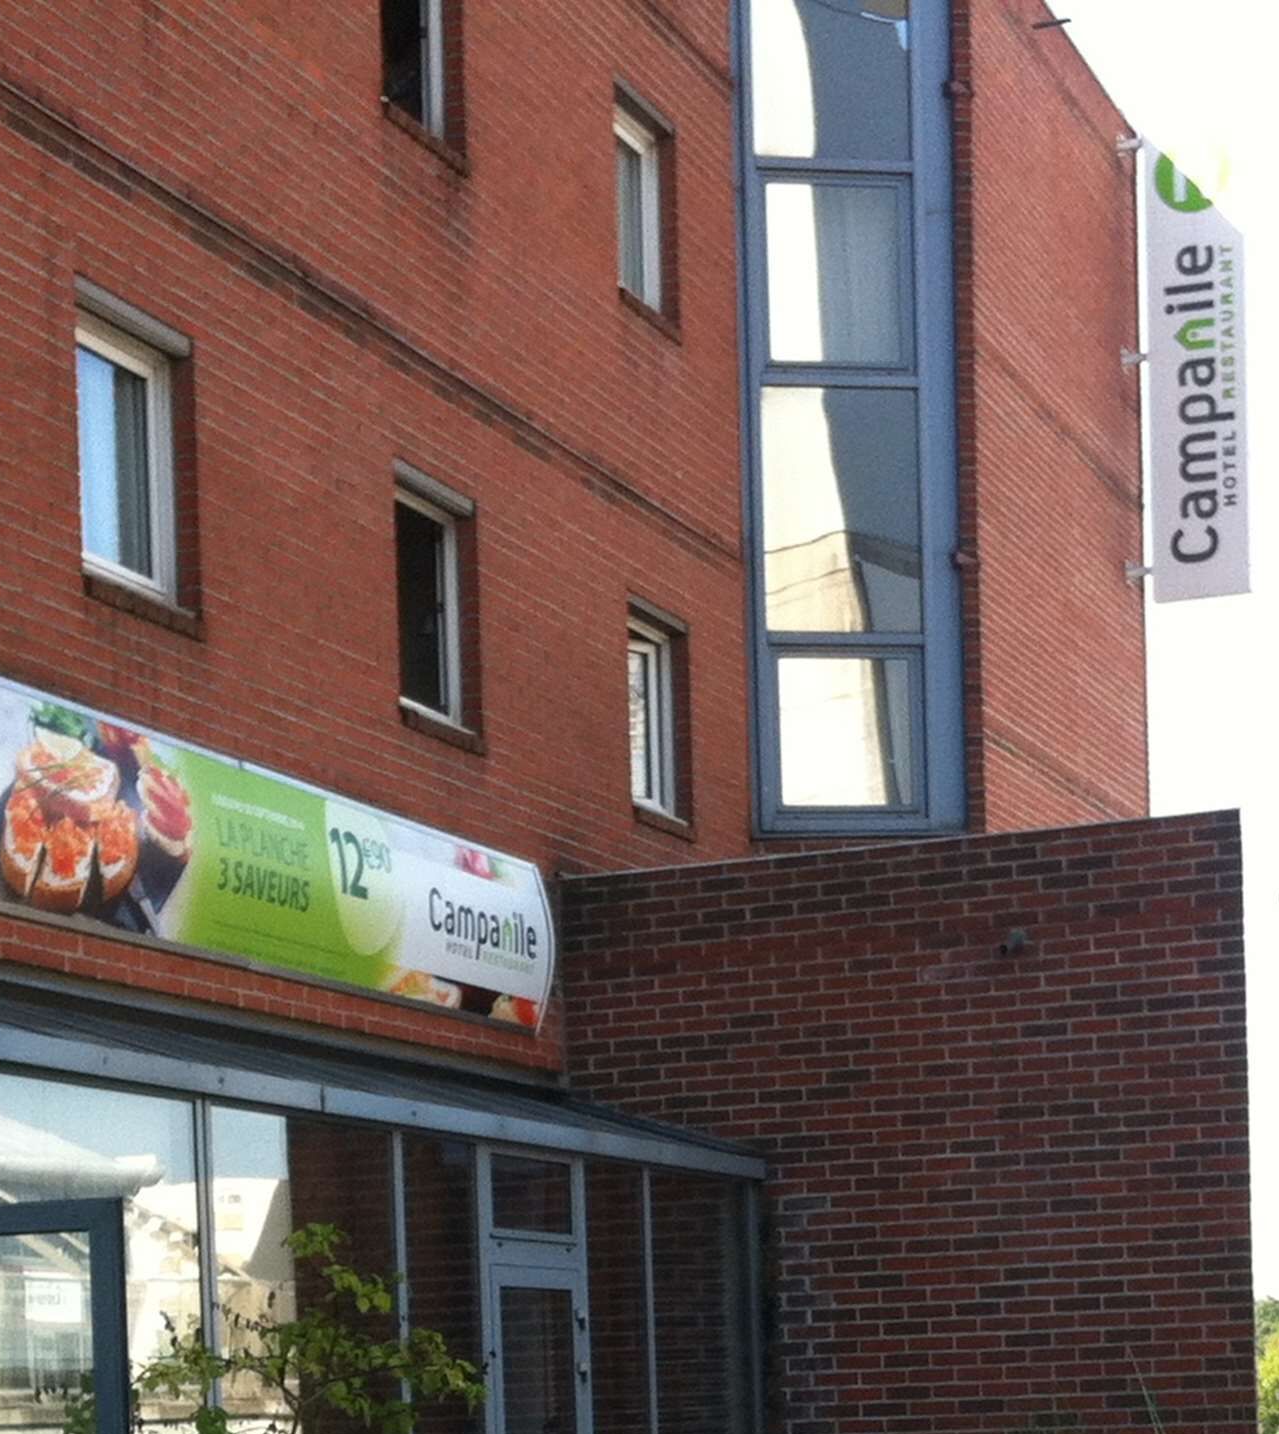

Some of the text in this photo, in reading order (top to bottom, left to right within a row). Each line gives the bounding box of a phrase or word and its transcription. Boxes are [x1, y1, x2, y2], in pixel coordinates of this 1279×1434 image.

[1163, 244, 1235, 563] Campanile
[1219, 245, 1238, 507] HOTEL RESTAURANT
[217, 857, 310, 913] 3 SAVEURS
[428, 887, 538, 960] Campanile
